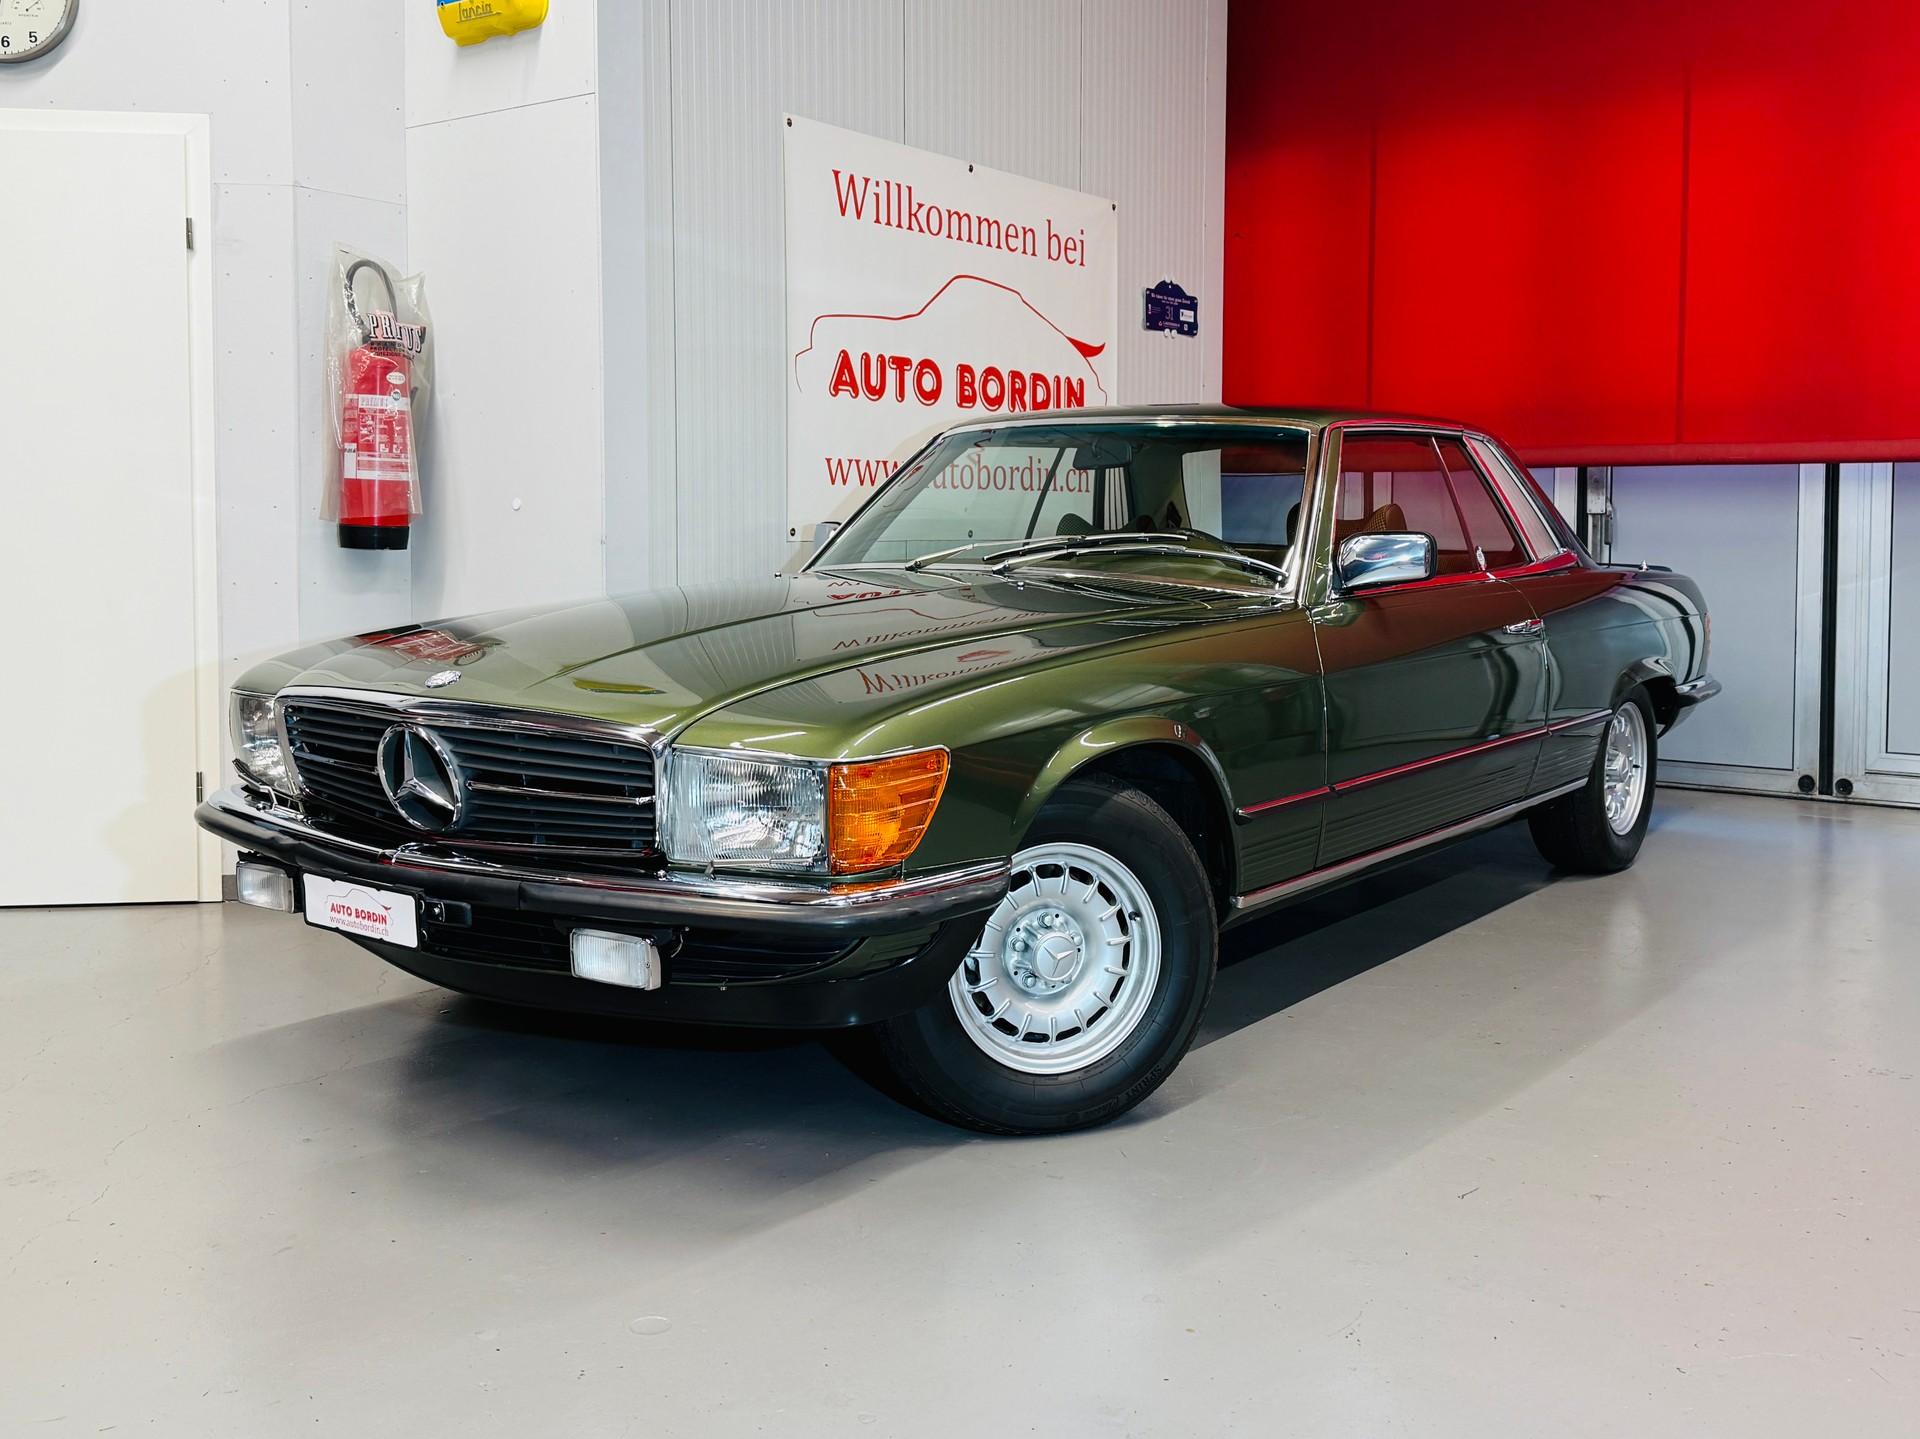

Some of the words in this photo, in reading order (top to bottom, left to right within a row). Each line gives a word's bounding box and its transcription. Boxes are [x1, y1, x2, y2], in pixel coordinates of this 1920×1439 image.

[1, 35, 11, 48] 6
[28, 31, 38, 43] 5
[831, 168, 1038, 258] Willkommen
[1046, 218, 1086, 267] bei
[366, 313, 422, 353] PRIUS
[828, 348, 943, 407] AUTO
[955, 363, 1086, 413] BORDIN
[824, 453, 1091, 494] wwutobordin.ch
[329, 915, 390, 937] www.autobordin.ch
[330, 902, 352, 917] AUTO
[354, 907, 387, 926] BORDIN
[1125, 1064, 1162, 1099] SPRINT
